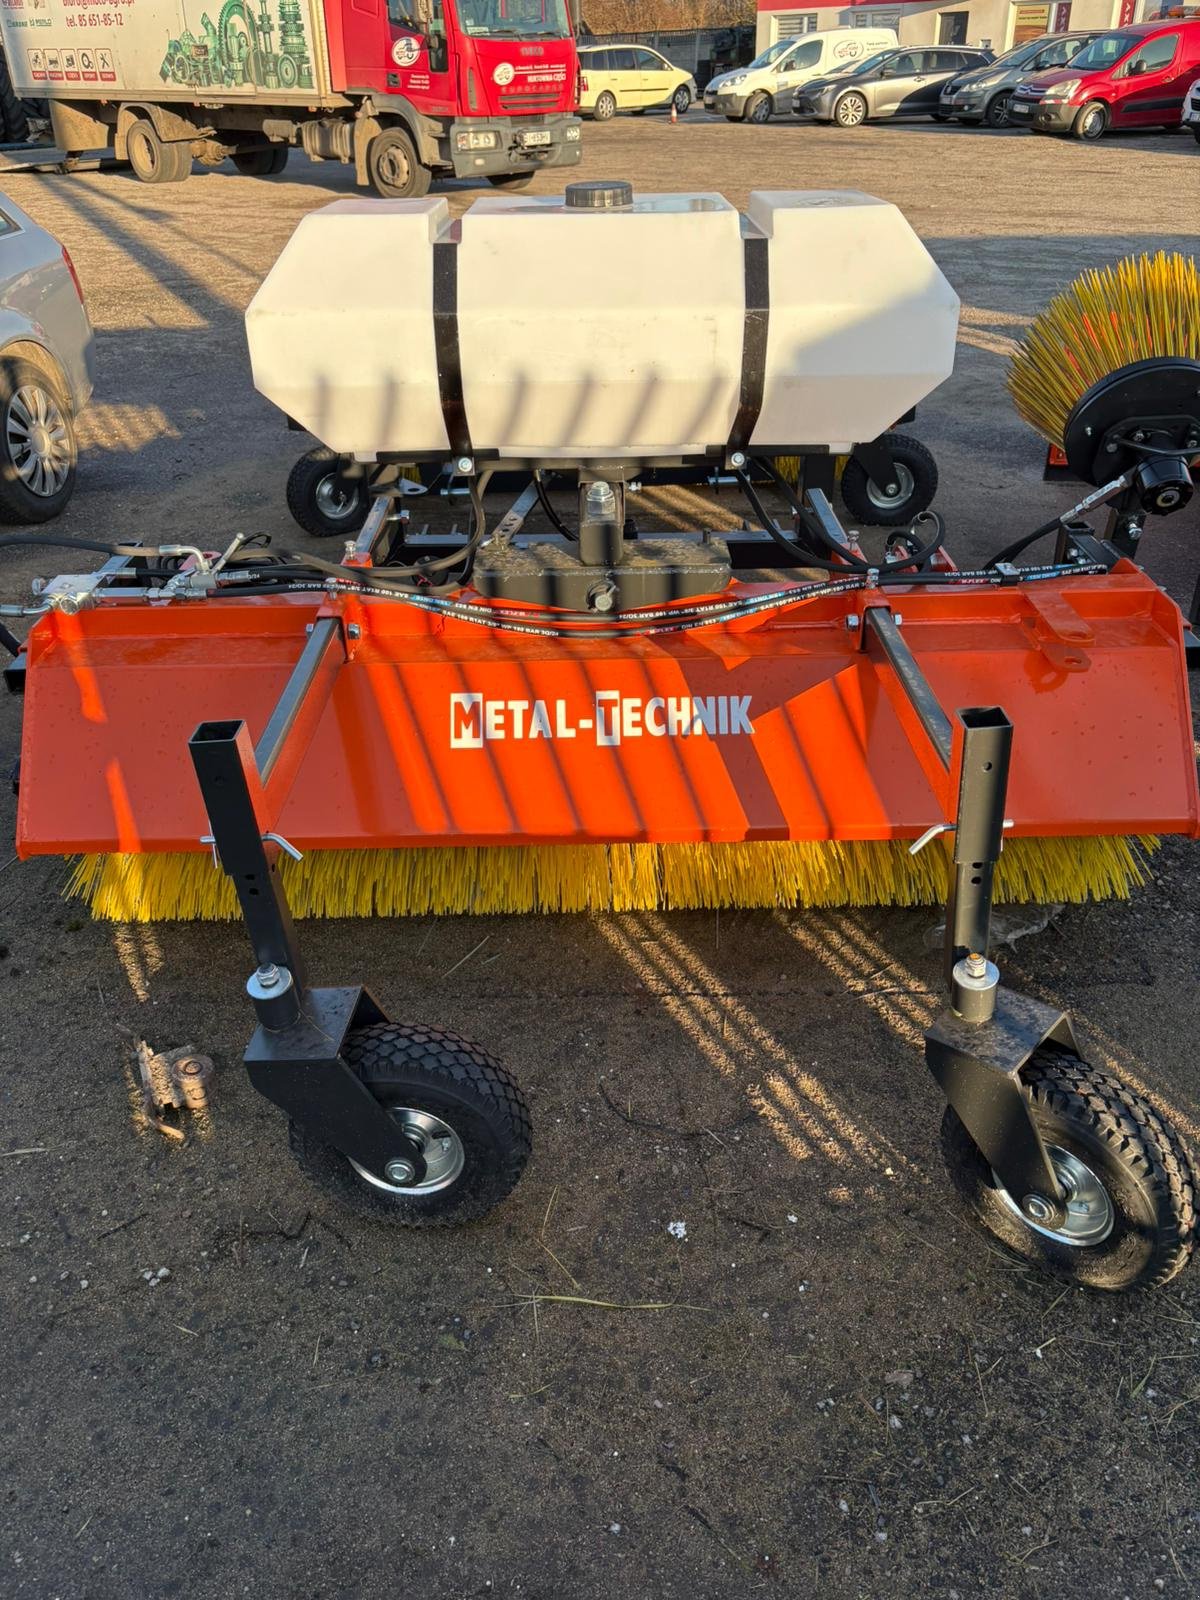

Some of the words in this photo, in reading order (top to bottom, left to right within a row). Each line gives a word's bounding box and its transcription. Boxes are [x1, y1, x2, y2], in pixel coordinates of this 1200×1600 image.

[66, 14, 78, 27] tel.
[78, 14, 87, 27] 85
[88, 13, 124, 26] 651-85-12
[450, 690, 756, 748] METAL-TECHNIK
